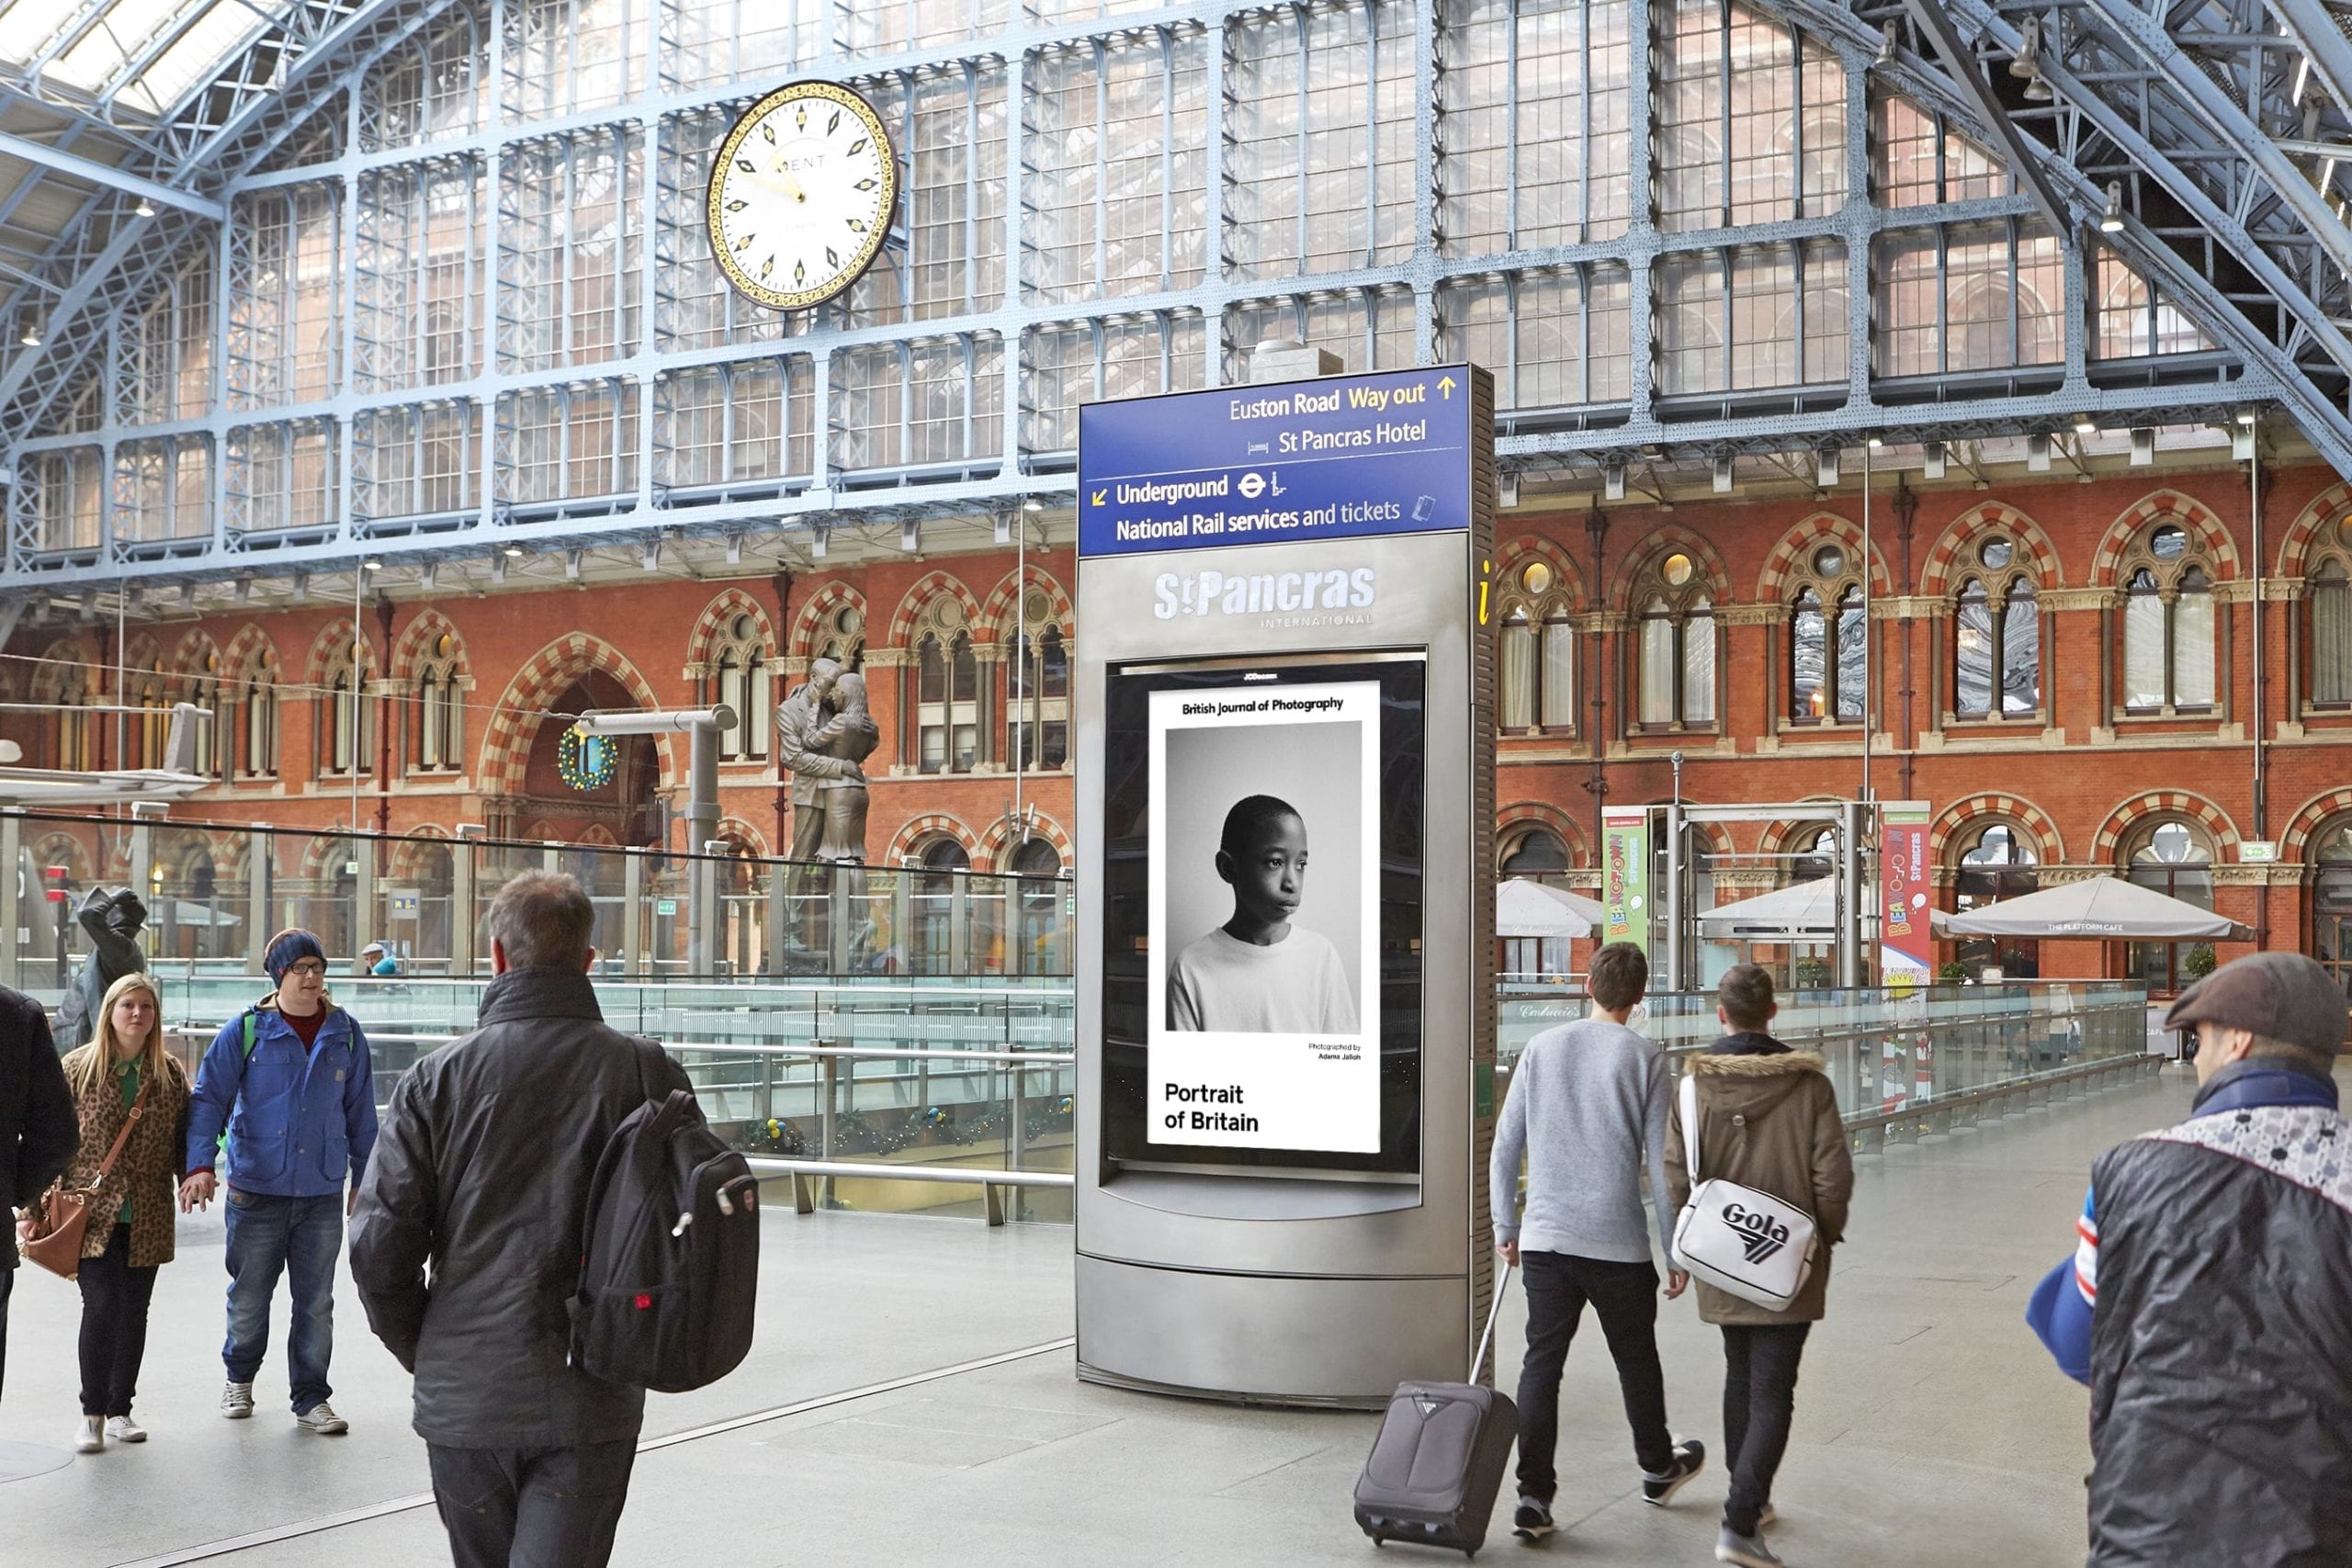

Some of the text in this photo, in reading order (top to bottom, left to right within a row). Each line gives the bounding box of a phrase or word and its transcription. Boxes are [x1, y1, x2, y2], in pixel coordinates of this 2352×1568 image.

[1230, 383, 1426, 421] Euston Road Way out
[1278, 419, 1426, 454] St Pancras Hotel
[1116, 474, 1228, 505] Underground
[1116, 501, 1401, 541] National Rail services and tickets
[1260, 615, 1374, 629] INTERNATIONAL
[1182, 696, 1344, 716] British Journal of Photography
[1352, 1043, 1362, 1052] by
[1166, 1083, 1244, 1104] Portrait
[1164, 1111, 1259, 1132] of Britain
[1722, 1203, 1790, 1245] Gola
